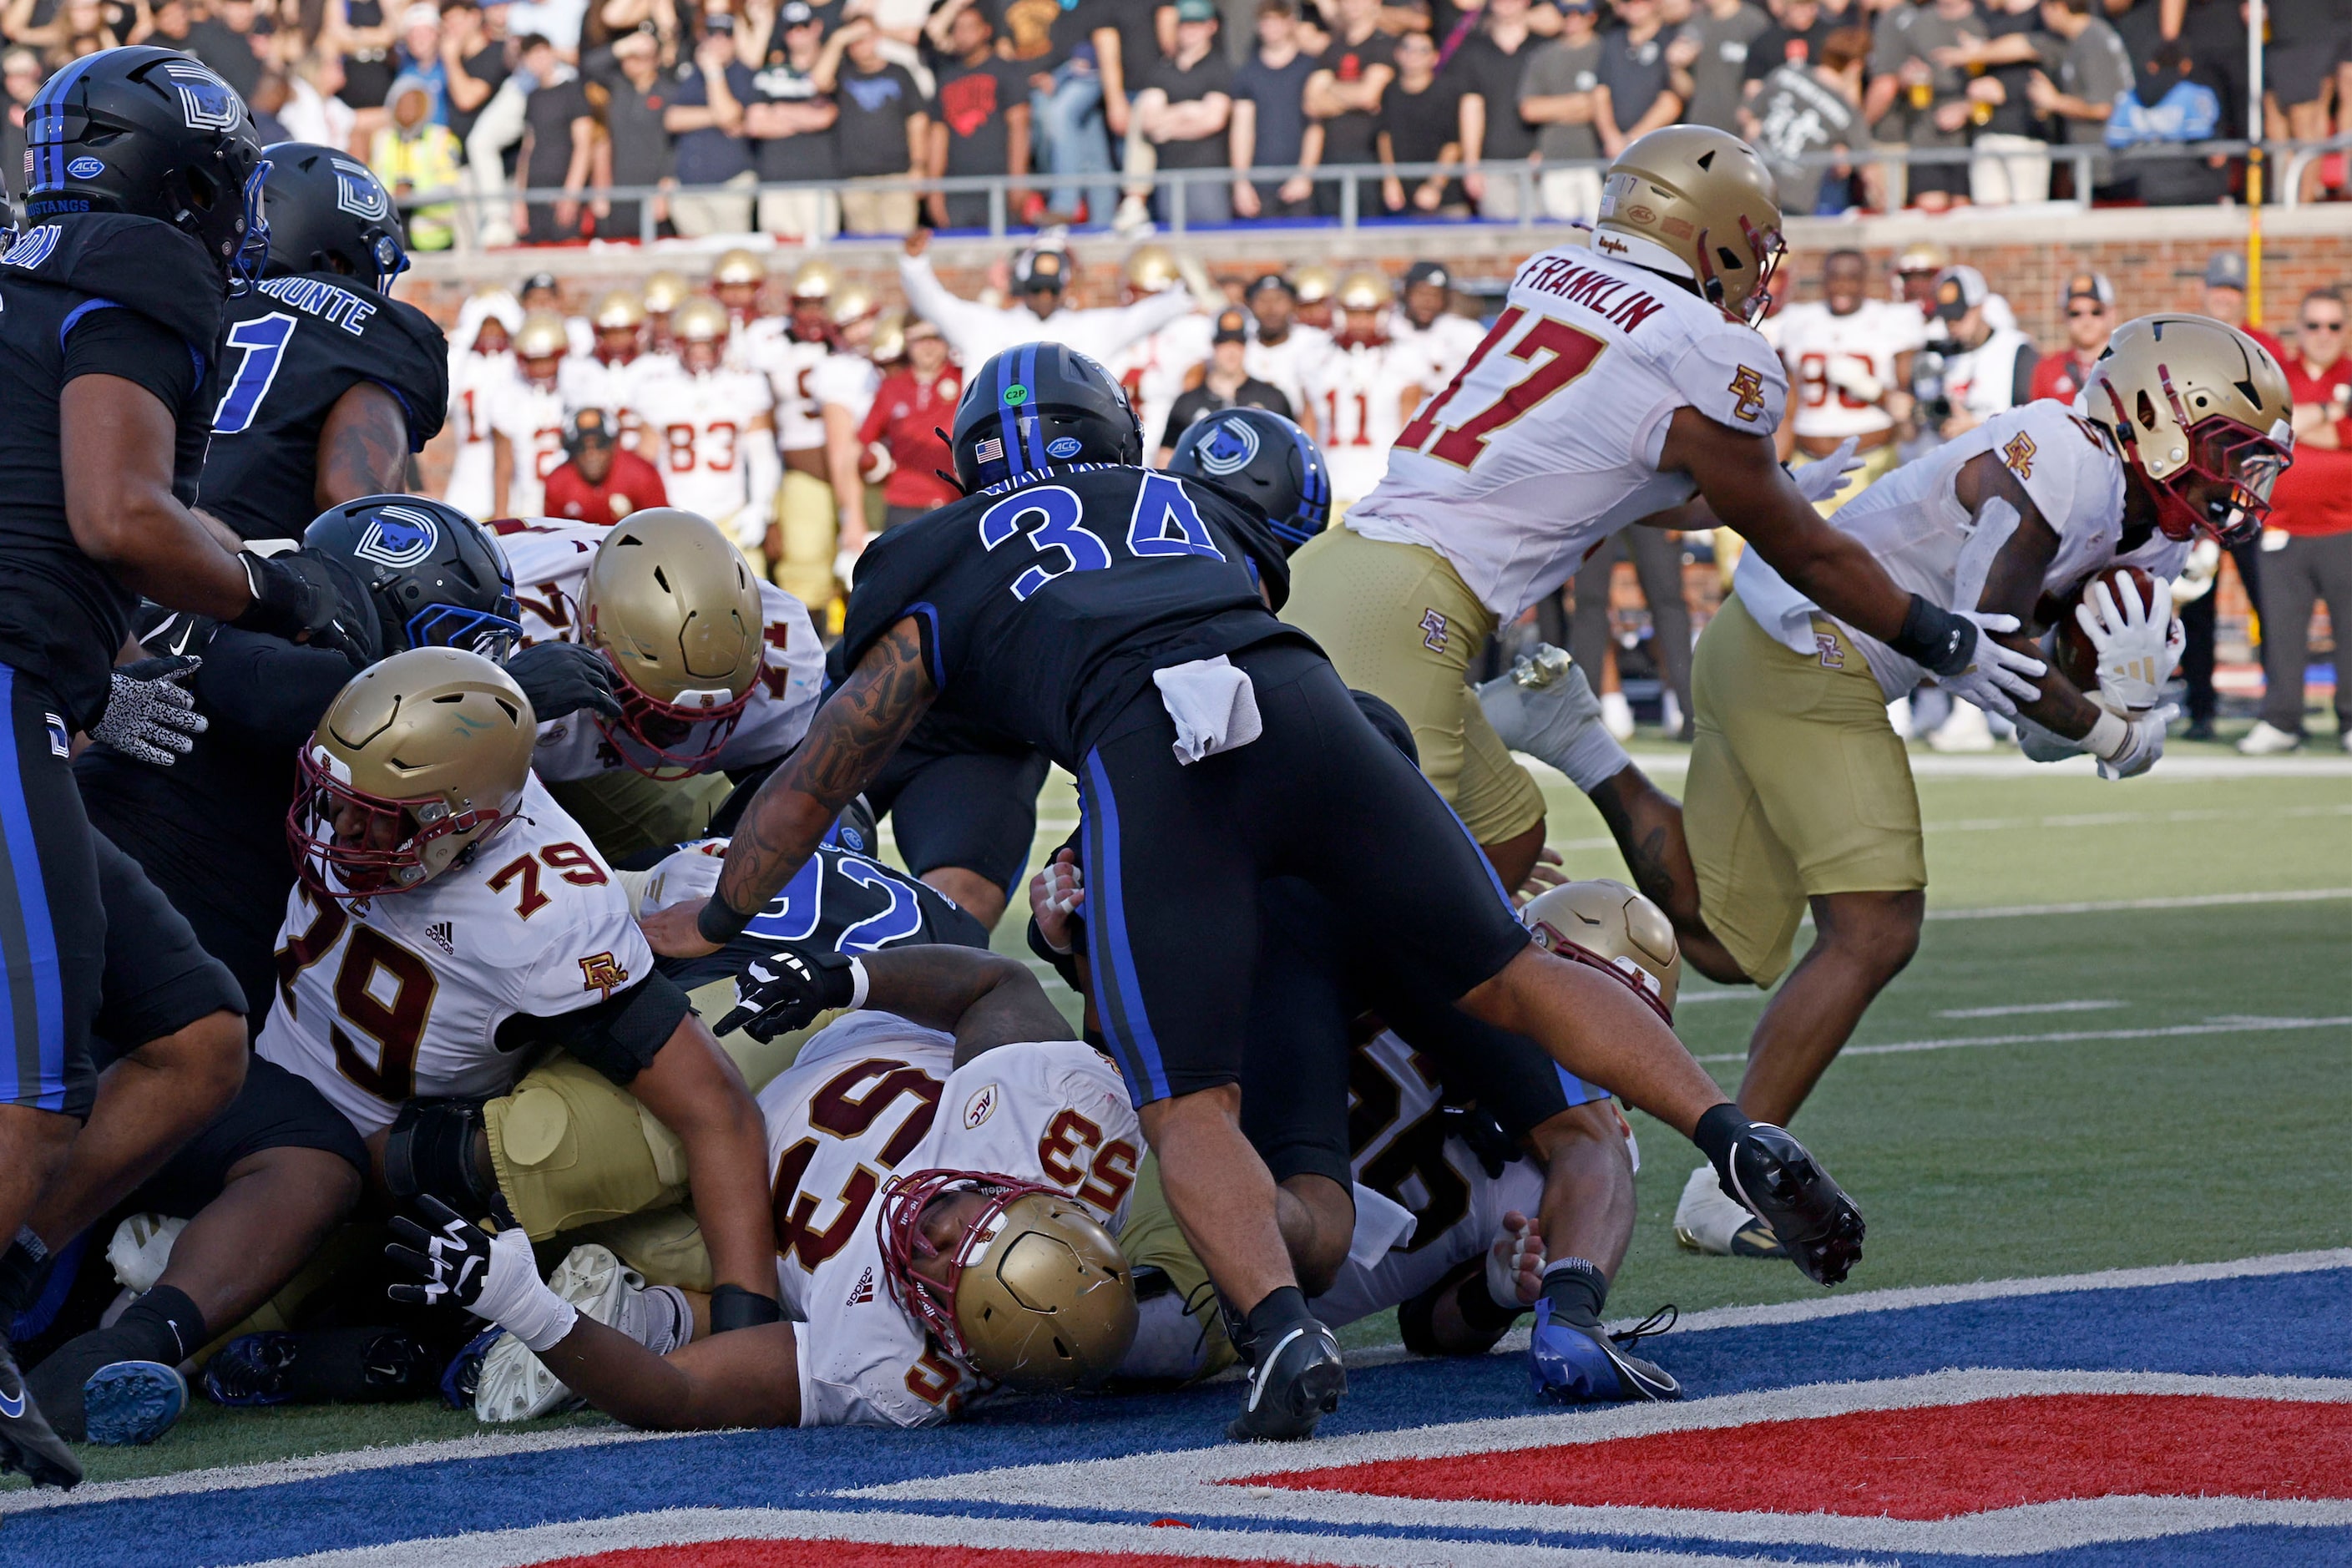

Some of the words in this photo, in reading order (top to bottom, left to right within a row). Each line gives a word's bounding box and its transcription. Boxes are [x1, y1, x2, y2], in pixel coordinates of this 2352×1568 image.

[27, 200, 90, 218] MUSTANGS
[1517, 254, 1666, 335] FRANKLIN
[210, 311, 298, 434] 1
[1005, 389, 1025, 399] C2P
[1393, 305, 1610, 472] 17
[667, 422, 736, 473] 83
[1327, 389, 1371, 447] 11
[978, 471, 1227, 601] 34
[487, 842, 609, 921] 79
[425, 928, 454, 955] adidas
[771, 1058, 945, 1275] 53
[1038, 1108, 1139, 1216] 53
[846, 1266, 872, 1308] adidas
